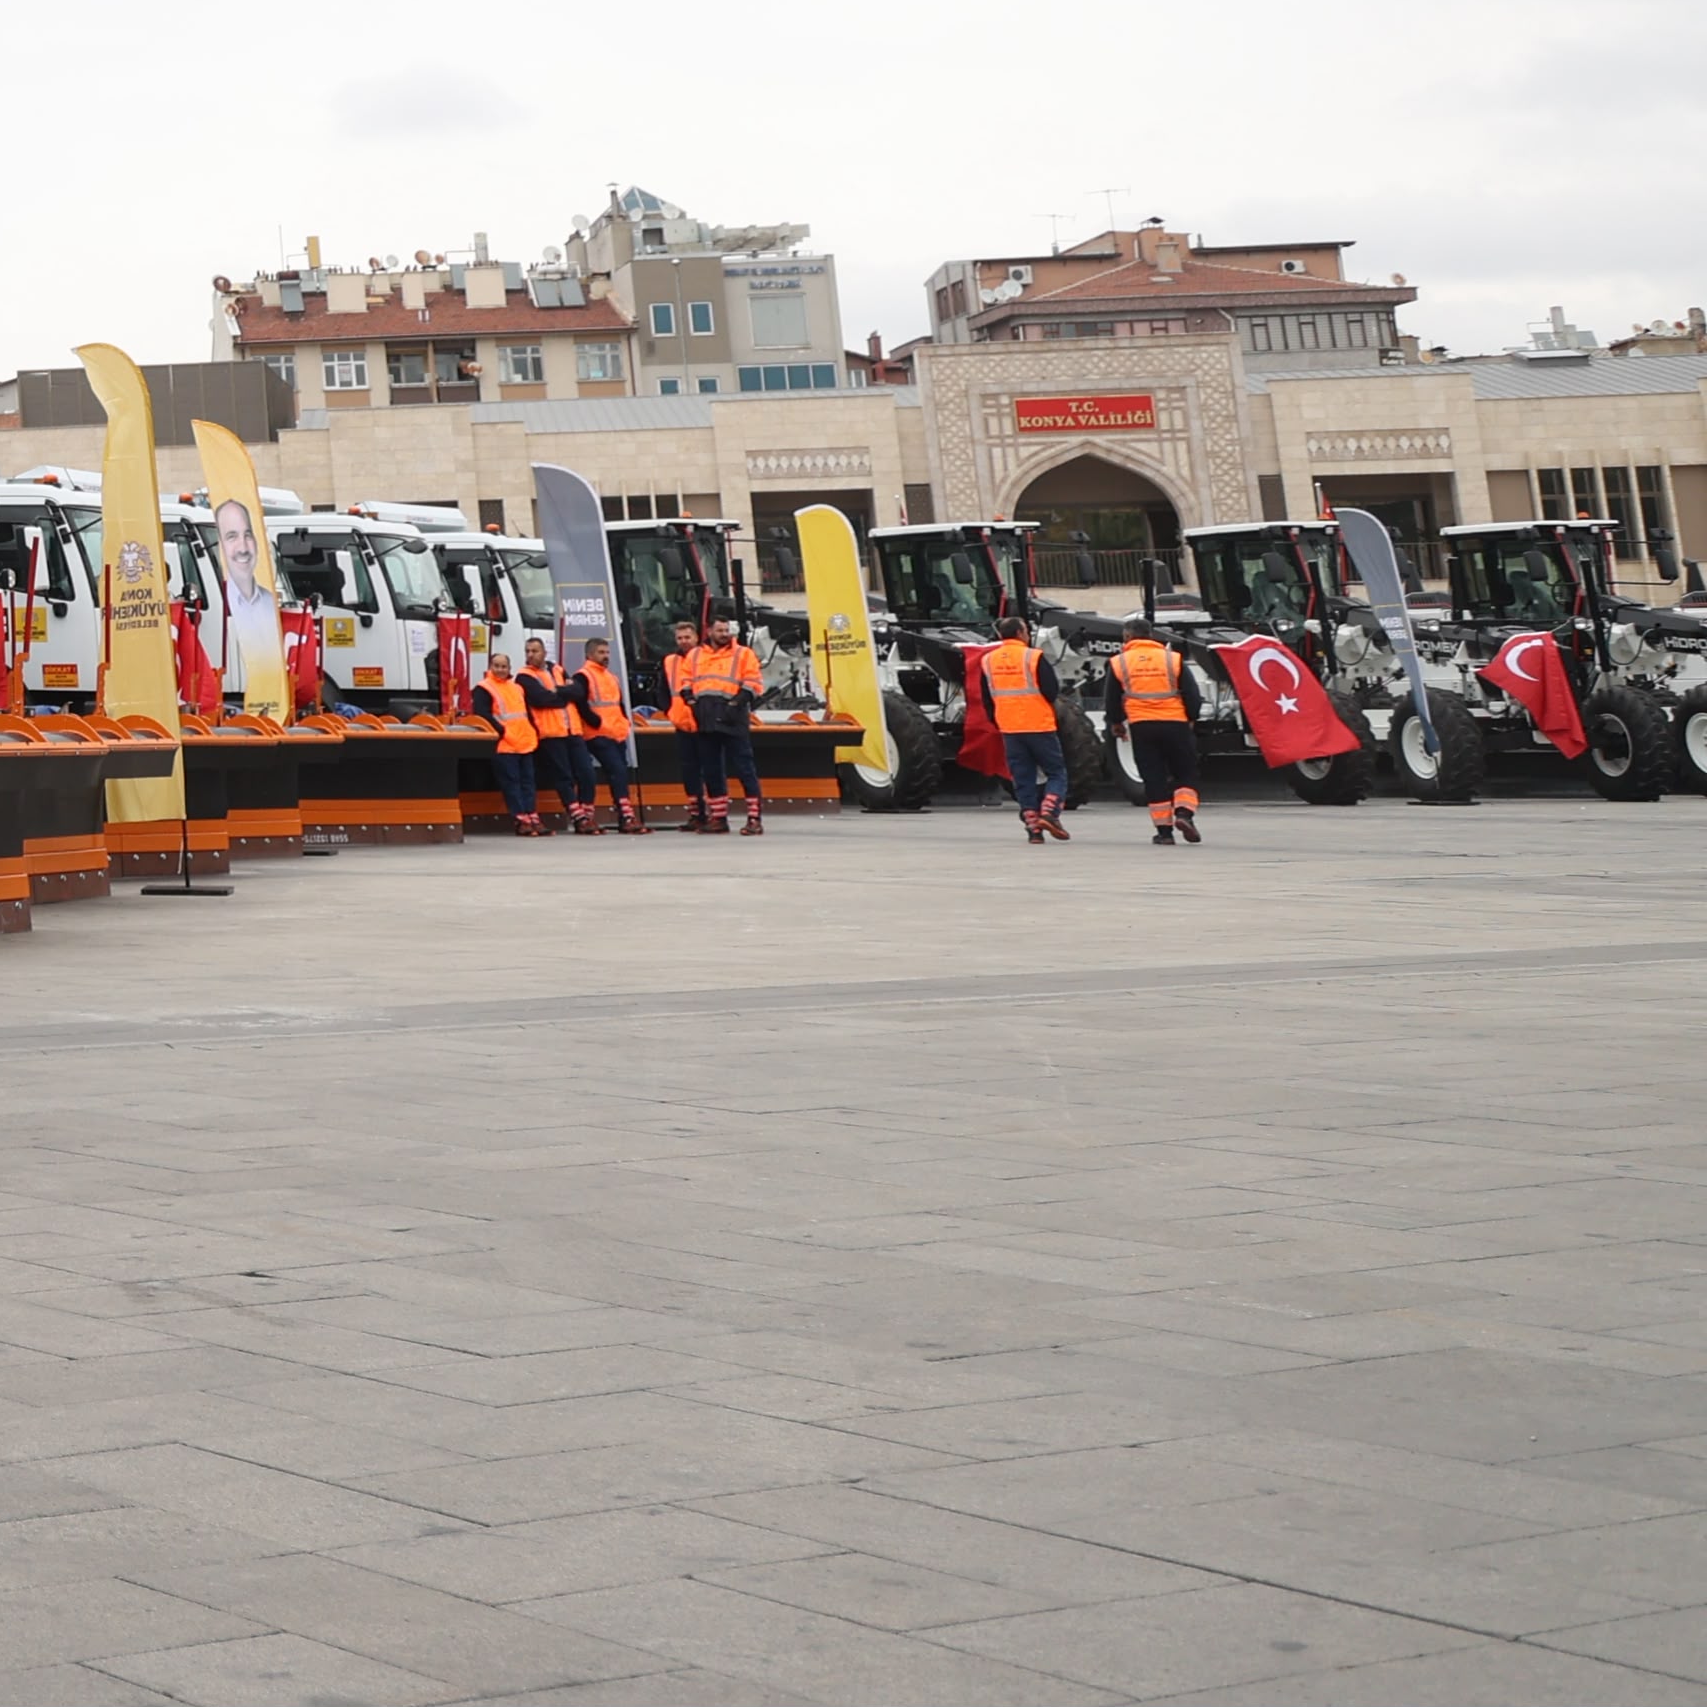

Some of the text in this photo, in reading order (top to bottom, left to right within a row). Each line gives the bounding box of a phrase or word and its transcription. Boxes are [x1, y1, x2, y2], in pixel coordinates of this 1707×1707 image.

[1068, 401, 1100, 413] T.C.
[1018, 410, 1154, 428] KONYA VALİLİĞİ
[1088, 640, 1122, 653] HİDR
[1413, 639, 1459, 653] ROMEK
[1664, 636, 1707, 650] HİDRO
